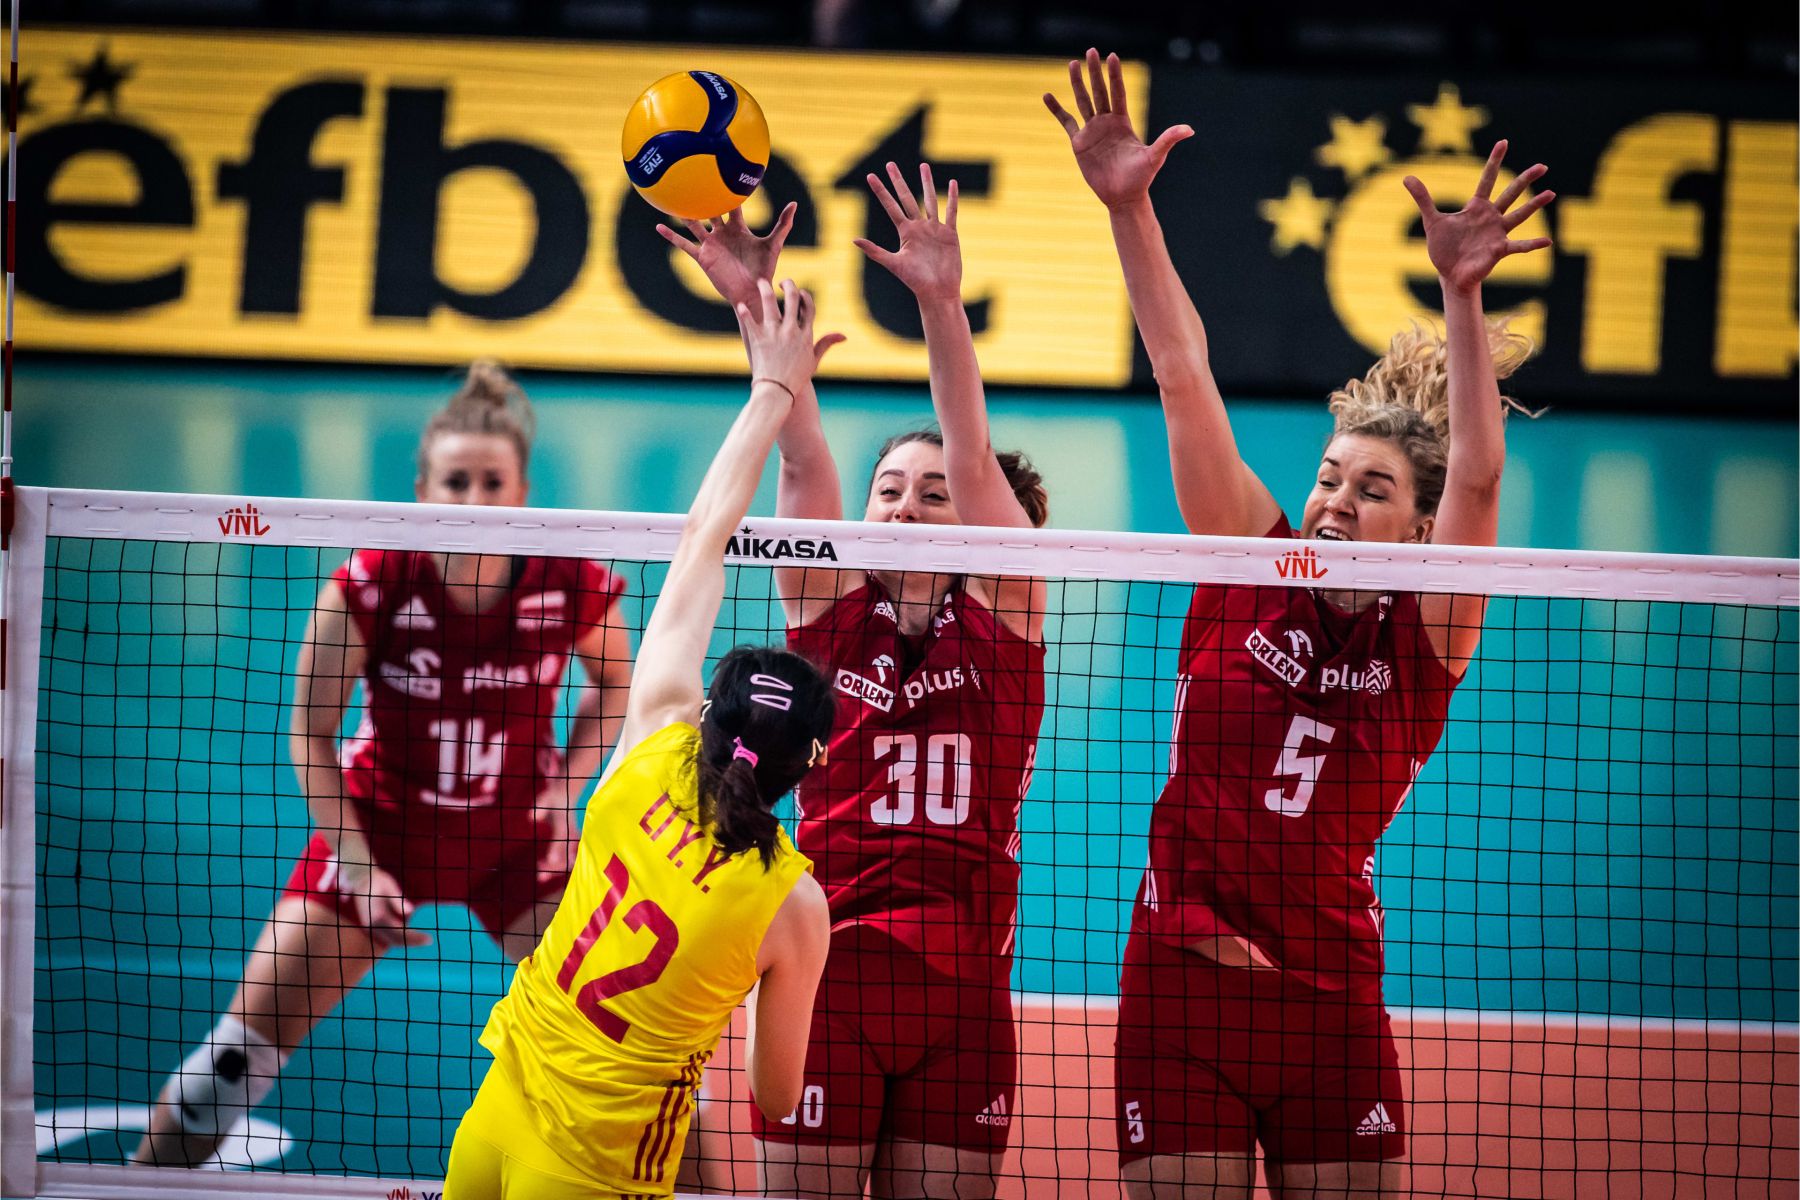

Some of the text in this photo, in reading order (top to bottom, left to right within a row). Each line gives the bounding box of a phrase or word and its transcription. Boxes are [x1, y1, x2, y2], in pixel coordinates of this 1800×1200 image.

[643, 153, 664, 175] FIVB
[217, 503, 271, 536] VNL
[1275, 545, 1329, 579] VNL
[1249, 634, 1301, 683] ORLEN
[838, 672, 890, 709] ORLEN
[903, 666, 965, 709] plus
[1320, 663, 1366, 694] plu
[870, 733, 972, 826] 30
[1264, 713, 1337, 818] 5
[556, 852, 679, 1044] 12
[975, 1113, 1009, 1126] adidas
[1356, 1120, 1396, 1136] adidas
